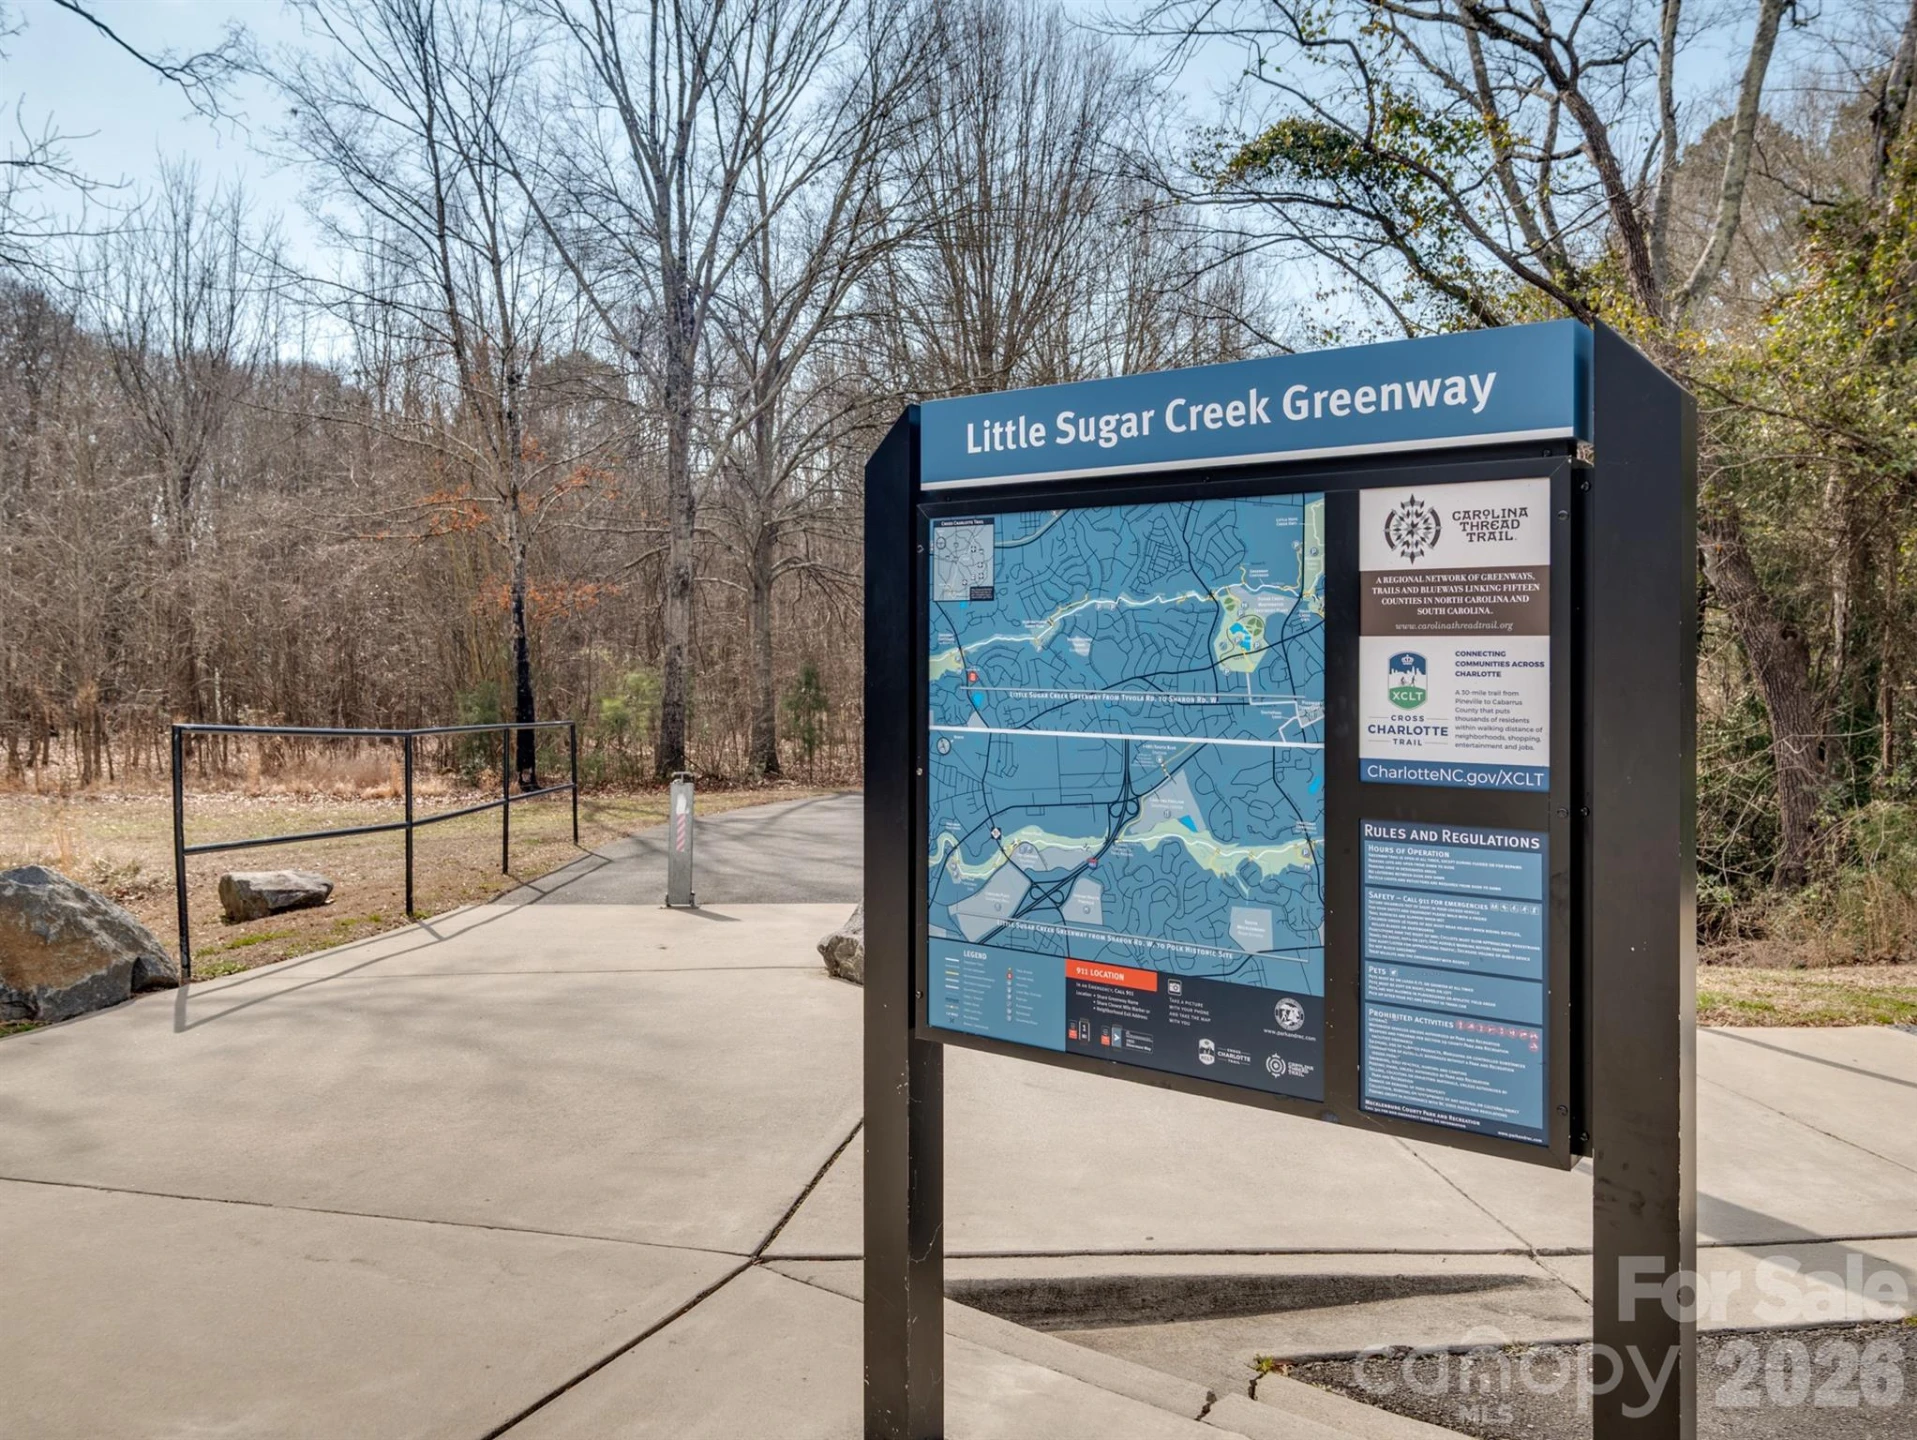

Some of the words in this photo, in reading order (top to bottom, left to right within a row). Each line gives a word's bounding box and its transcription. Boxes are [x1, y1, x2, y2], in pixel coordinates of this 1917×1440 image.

[966, 415, 1046, 455] Little
[1056, 406, 1155, 449] Sugar
[1165, 388, 1271, 433] Creek
[1282, 371, 1497, 422] Greenway
[1452, 507, 1529, 521] CAROLINA
[1460, 519, 1520, 532] THREAD
[1375, 576, 1382, 584] A
[1383, 575, 1424, 584] REGIONAL
[1425, 574, 1467, 583] NETWORK
[1467, 574, 1480, 582] OF
[1372, 587, 1401, 595] TRAILS
[1401, 586, 1419, 594] AND
[1420, 585, 1464, 594] BLUEWAYS
[1465, 584, 1501, 593] LINKING
[1503, 583, 1540, 592] FIFTEEN
[1381, 597, 1423, 605] COUNTIES
[1423, 597, 1433, 605] IN
[1434, 596, 1464, 604] NORTH
[1465, 595, 1509, 604] CAROLINA
[1509, 595, 1529, 603] AND
[1417, 607, 1446, 616] SOUTH
[1395, 621, 1513, 631] www.carolinathreadtrail.org
[1455, 650, 1506, 658] CONNECTING
[1455, 660, 1510, 668] COMMUNITIES
[1511, 660, 1545, 668] ACROSS
[1455, 670, 1502, 678] CHARLOTTE
[1392, 691, 1424, 702] XCLT
[1391, 714, 1425, 722] CROSS
[1368, 724, 1449, 737] CHARLOTTE
[1393, 738, 1423, 746] TRAIL
[1367, 765, 1545, 786] CharlotteNC.gov/XCLT
[1364, 823, 1407, 839] RULES
[1410, 829, 1439, 842] AND
[1442, 829, 1541, 849] REGULATIONS
[963, 950, 987, 960] LEGEND
[1076, 967, 1088, 976] 911
[1090, 969, 1125, 981] LOCATION
[1217, 1051, 1251, 1062] CHARLOTTE
